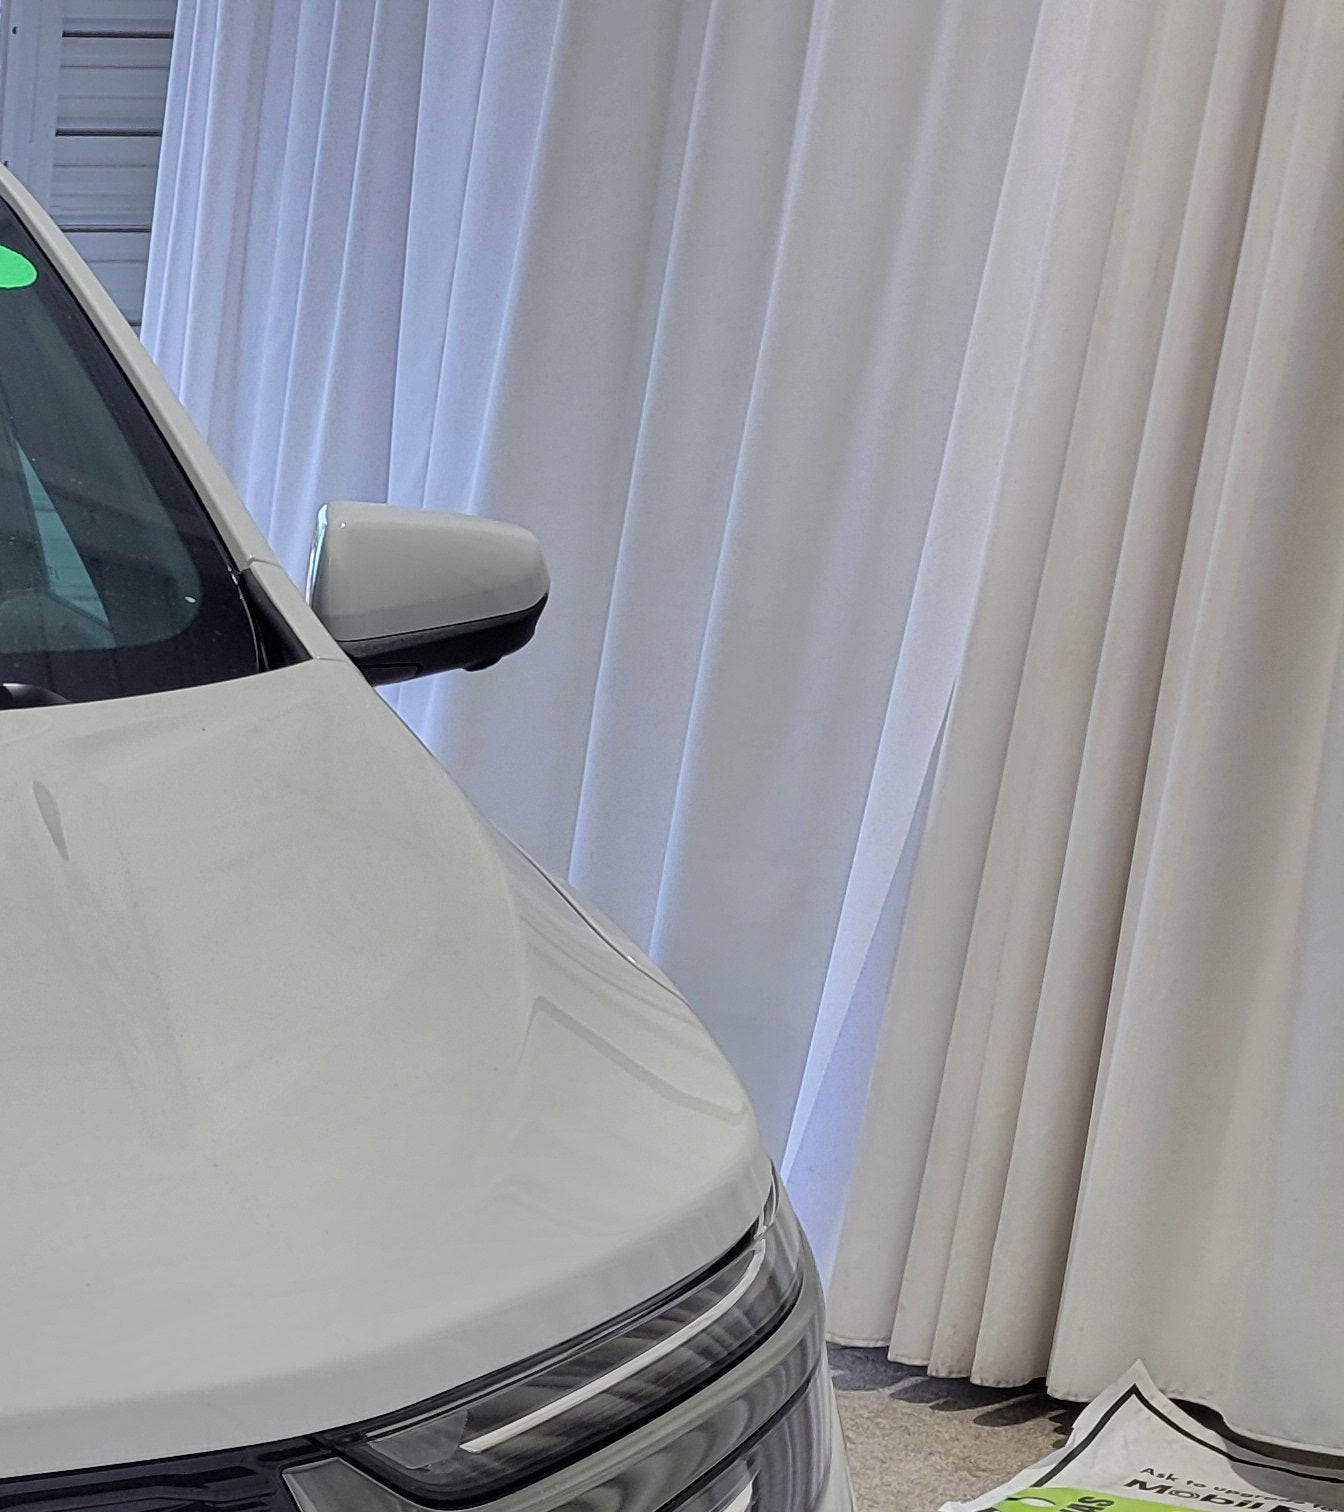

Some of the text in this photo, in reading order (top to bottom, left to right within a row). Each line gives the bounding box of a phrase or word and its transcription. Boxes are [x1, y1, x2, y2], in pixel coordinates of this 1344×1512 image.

[1139, 1467, 1179, 1482] Ask
[1186, 1479, 1207, 1488] to
[1123, 1478, 1265, 1510] Mobil
